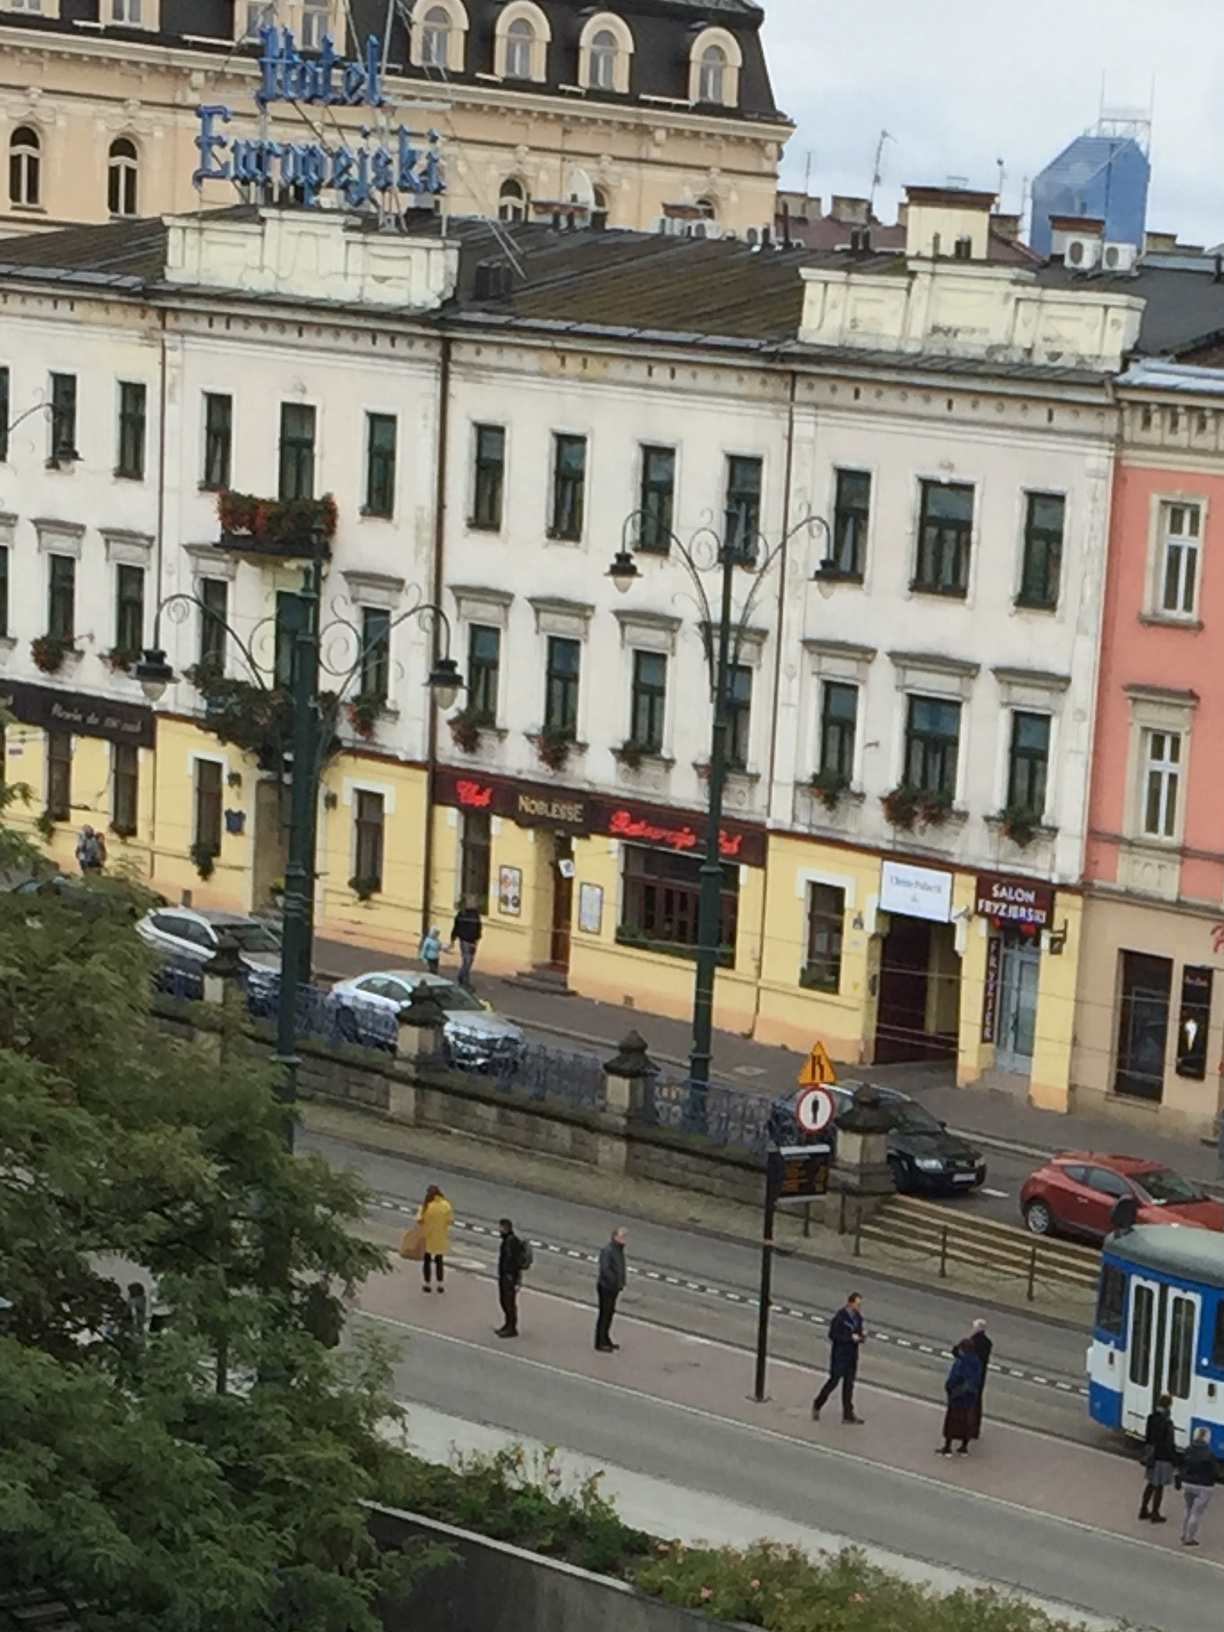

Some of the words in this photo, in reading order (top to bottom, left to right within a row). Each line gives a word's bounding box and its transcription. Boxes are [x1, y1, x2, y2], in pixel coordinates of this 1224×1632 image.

[256, 24, 389, 112] Hotel
[192, 104, 446, 206] Europejski
[517, 795, 585, 823] NOBLESSE
[991, 883, 1036, 903] SALON
[978, 899, 1047, 923] FRYZJERSKI
